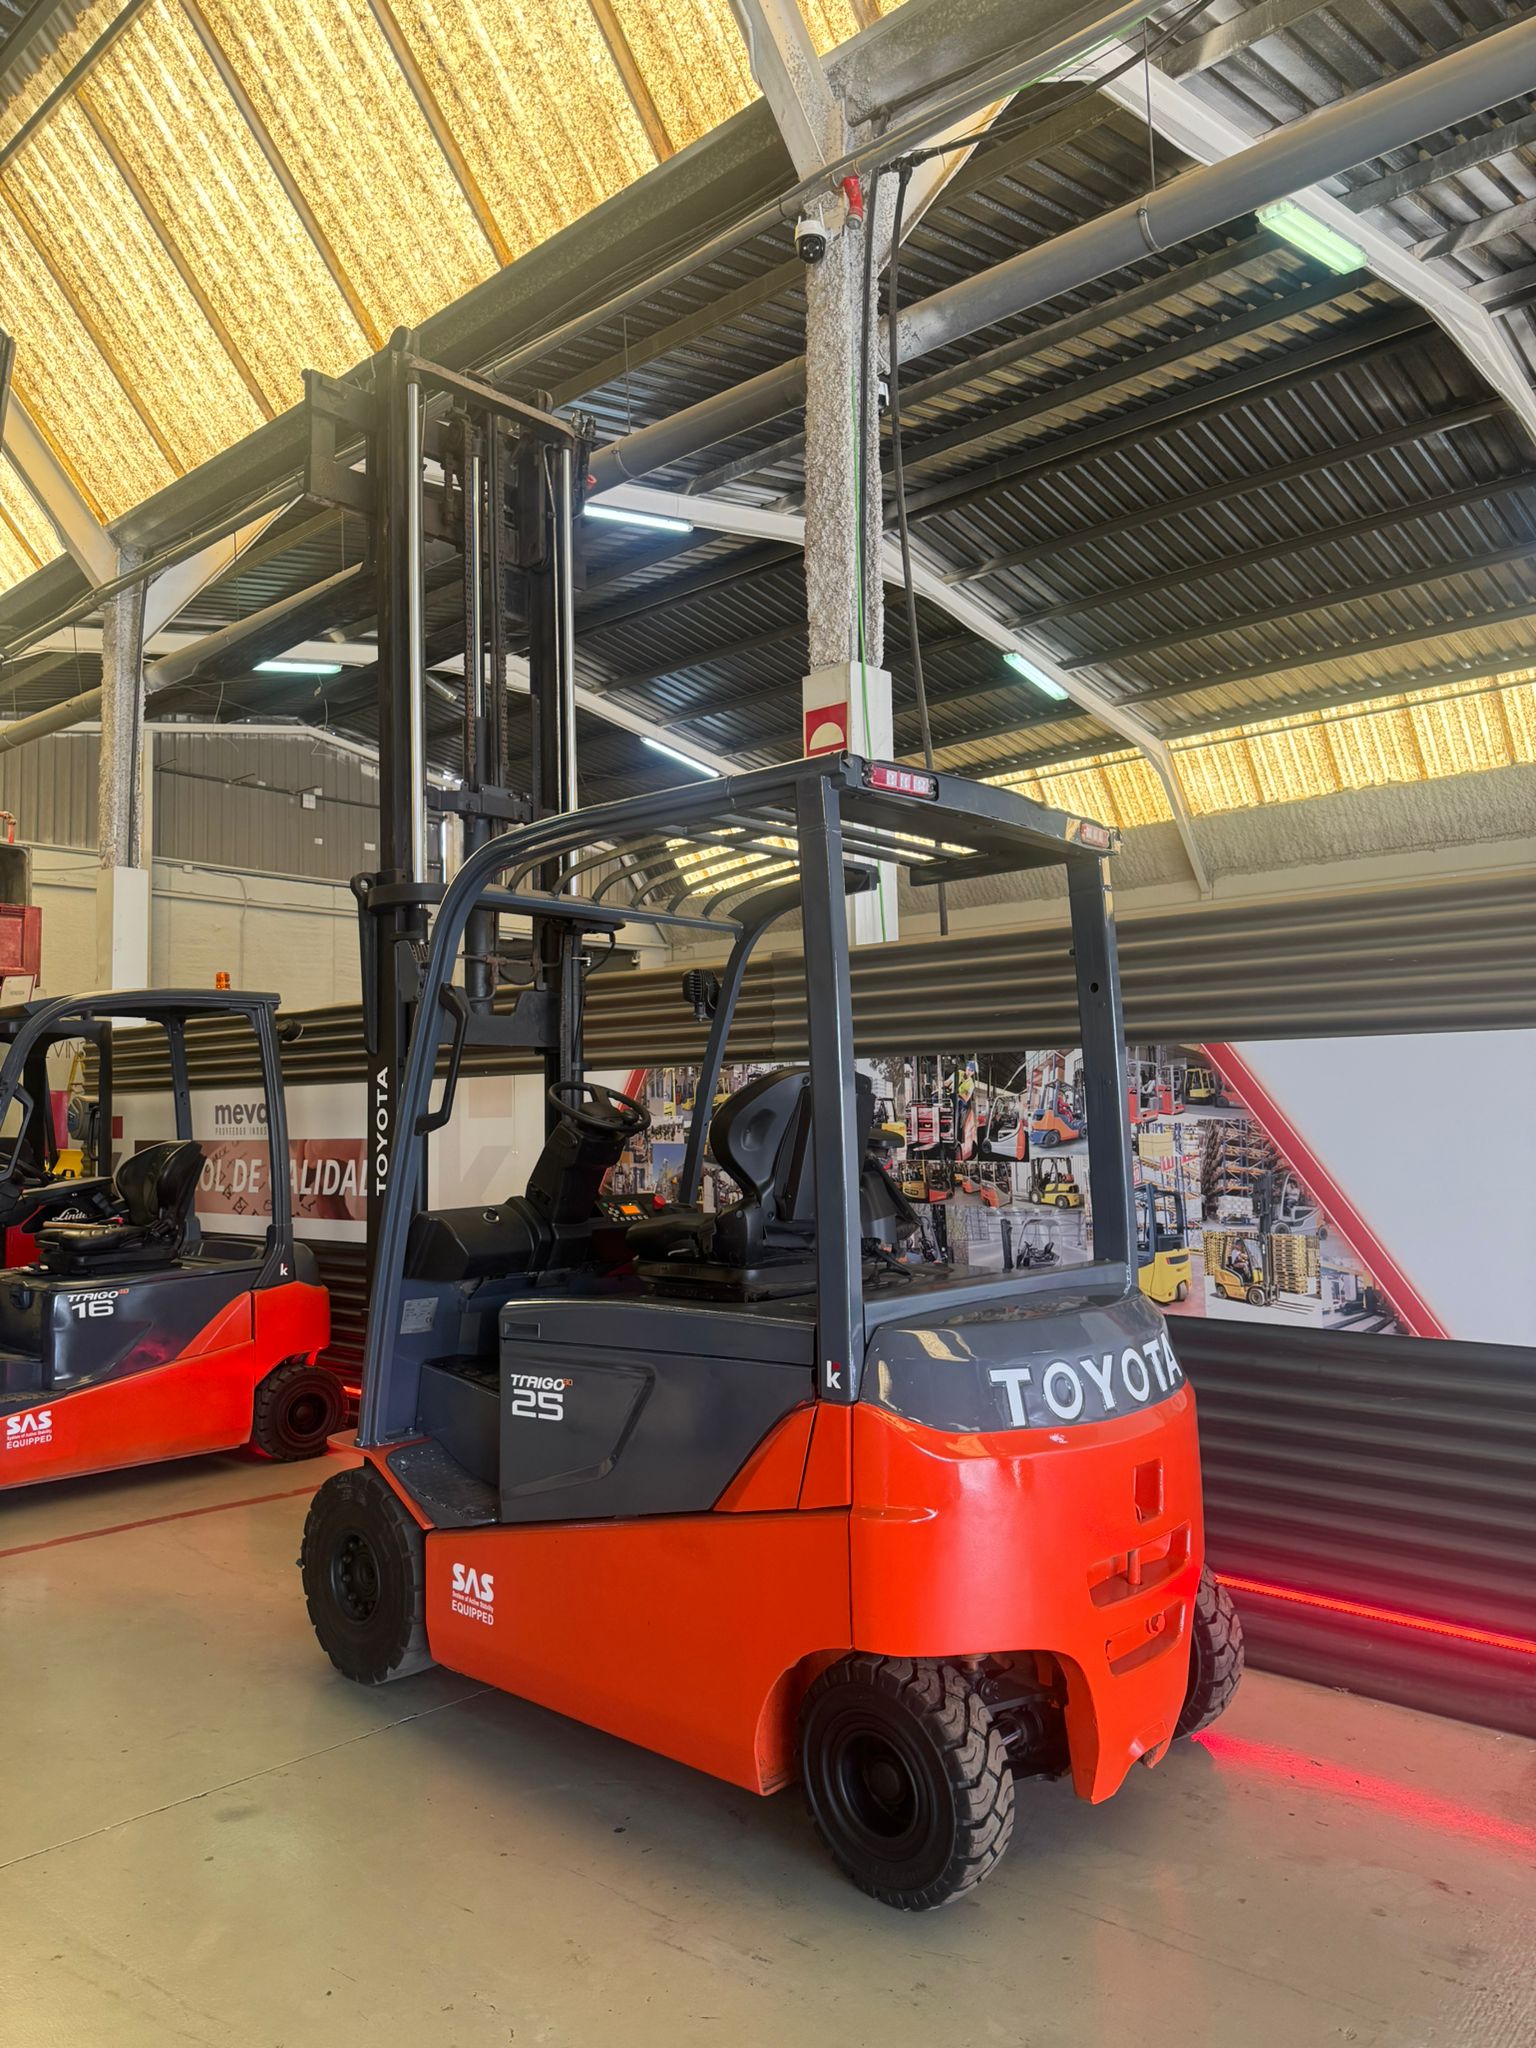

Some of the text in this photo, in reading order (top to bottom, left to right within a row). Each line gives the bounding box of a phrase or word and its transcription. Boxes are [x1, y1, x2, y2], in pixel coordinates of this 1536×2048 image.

[376, 1066, 389, 1197] TOYOTA
[232, 1158, 262, 1193] DE
[268, 1158, 368, 1197] ALIDA
[71, 1300, 115, 1319] 16
[989, 1332, 1183, 1427] TOYOTA
[511, 1388, 564, 1421] 25
[6, 1410, 53, 1435] SAS
[6, 1434, 53, 1449] EQUIPPED
[452, 1563, 494, 1603] SAS
[452, 1599, 494, 1626] EQUIPPED
